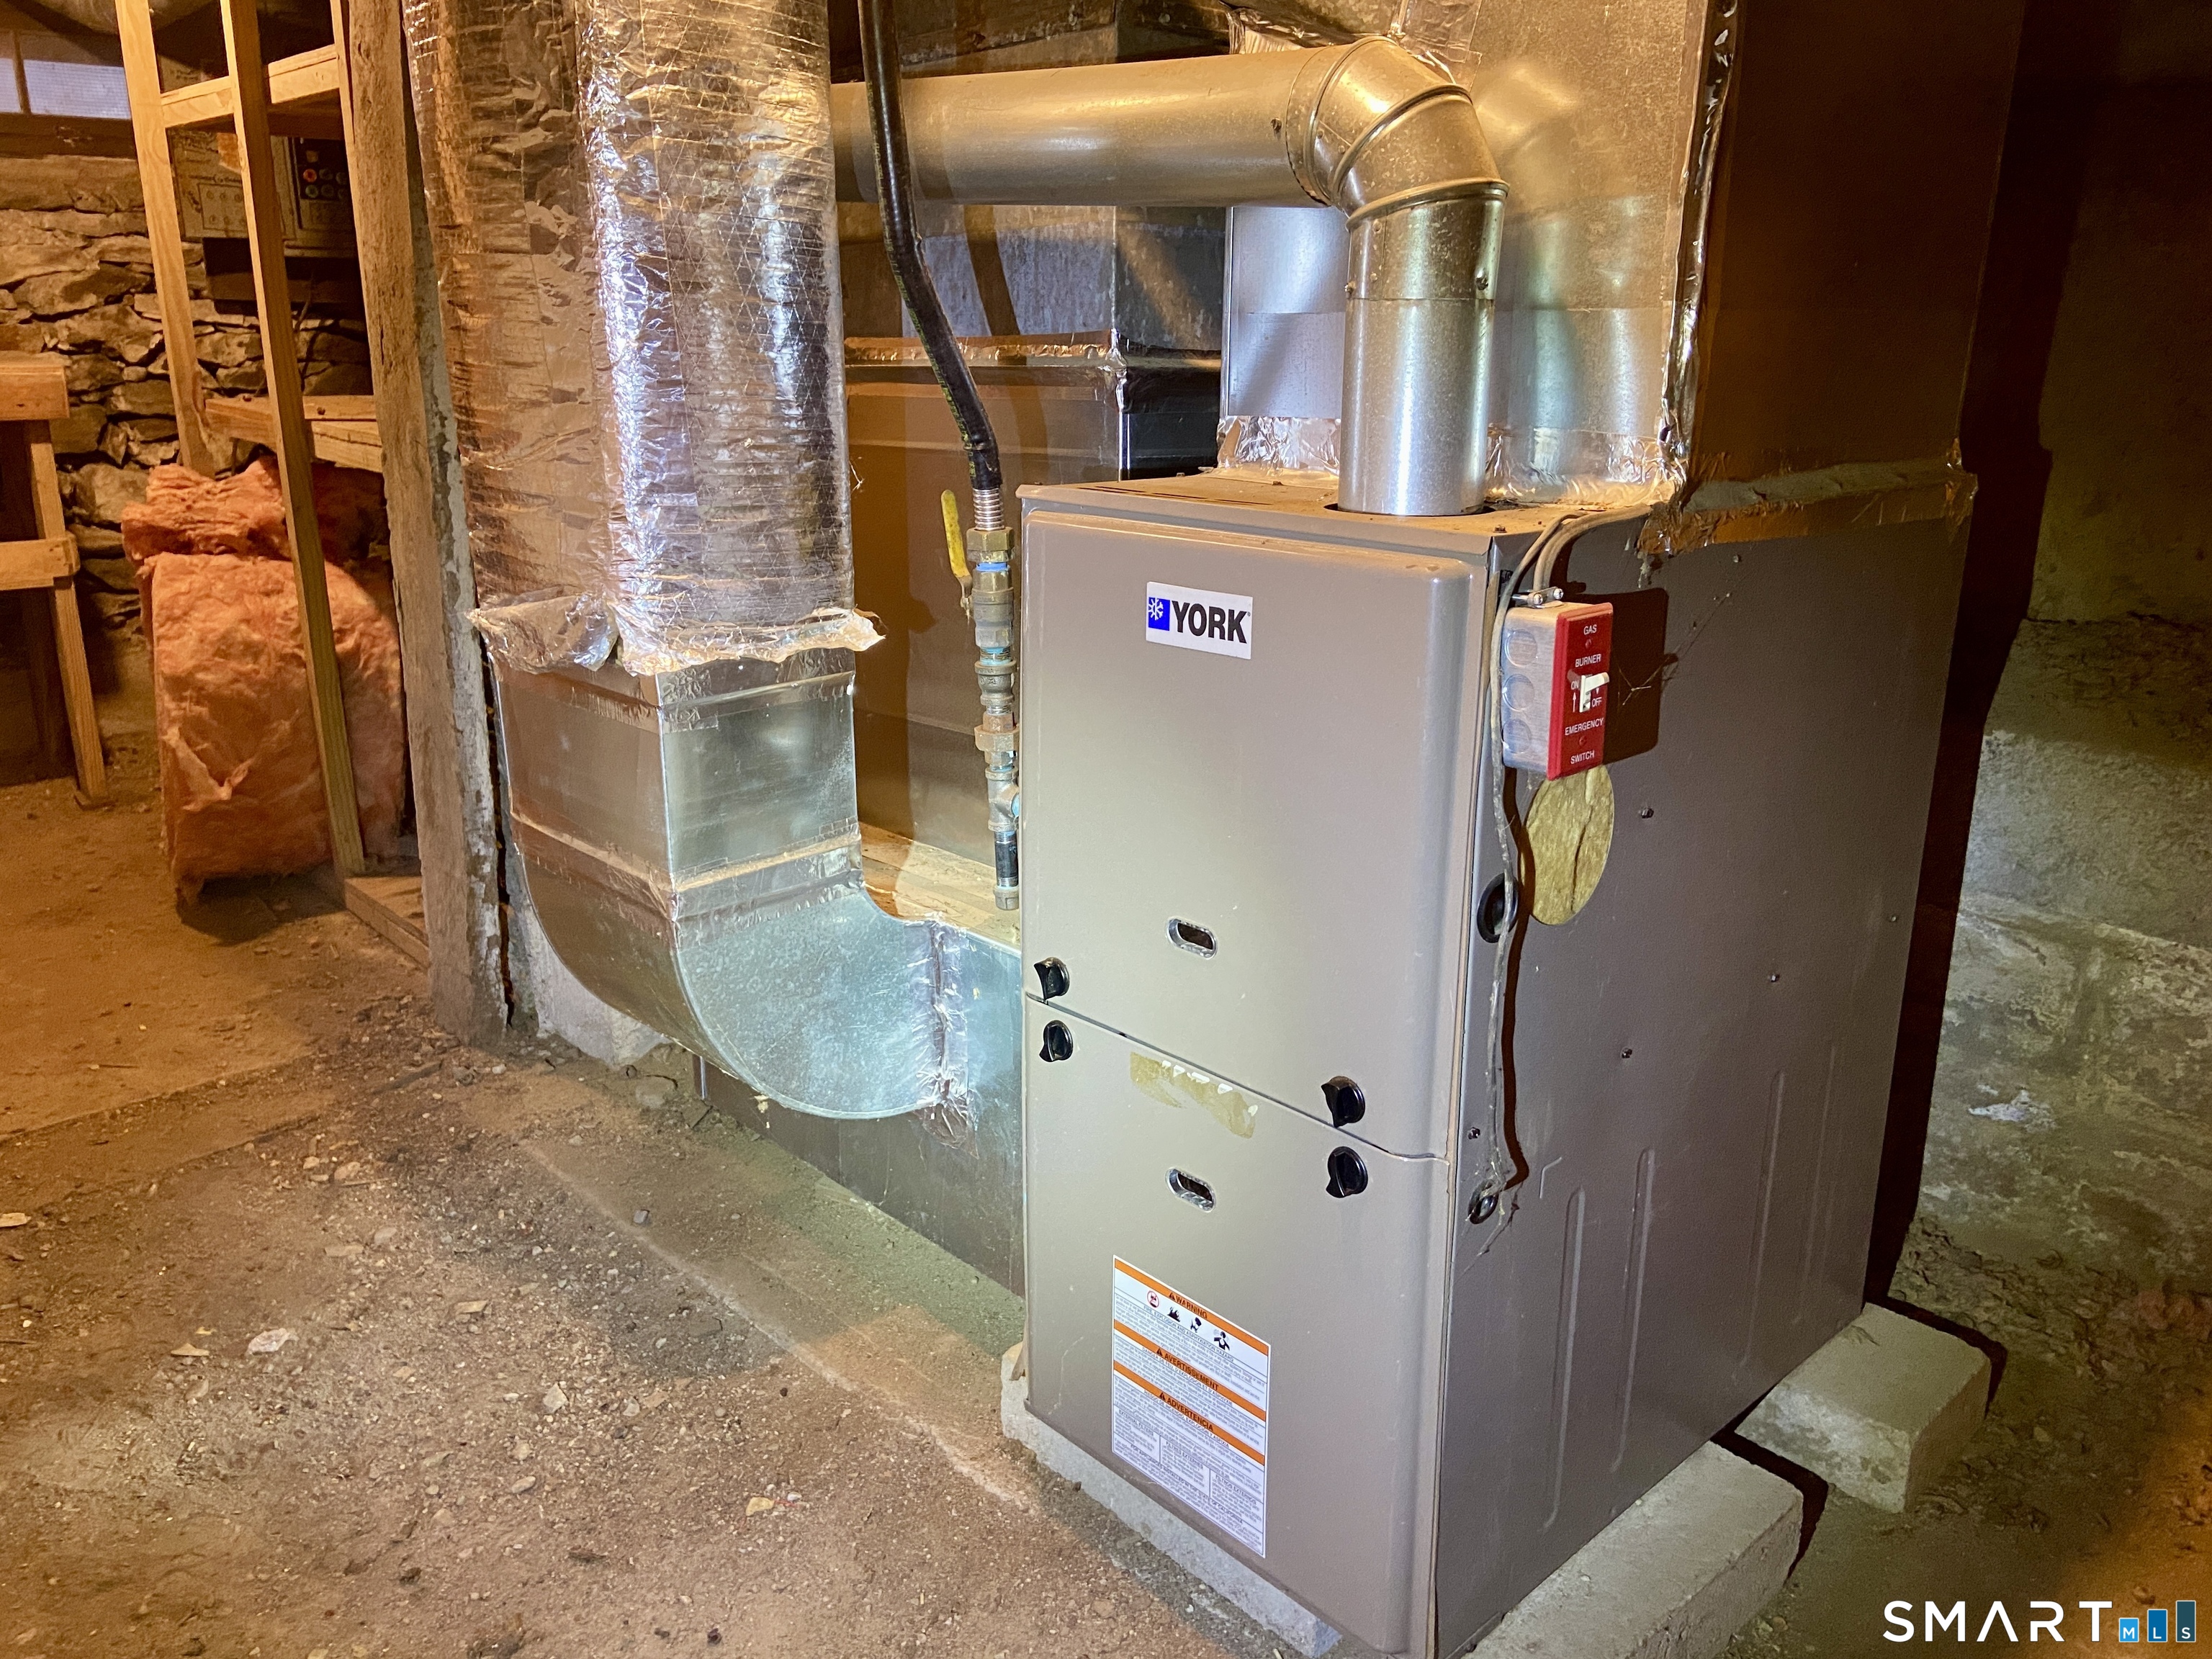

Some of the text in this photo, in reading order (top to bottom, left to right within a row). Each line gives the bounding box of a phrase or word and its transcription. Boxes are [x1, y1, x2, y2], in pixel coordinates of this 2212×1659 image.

[1172, 601, 1247, 644] YORK
[1583, 624, 1597, 636] GAS
[1575, 654, 1601, 667] BURNER
[1570, 680, 1580, 691] ON
[1592, 696, 1602, 708] OFF
[1565, 717, 1604, 736] EMERGENCY
[1570, 750, 1594, 765] SWITCH
[1176, 1295, 1207, 1319] WARNING
[1164, 1352, 1218, 1391] AVERTISSEMENT
[1166, 1395, 1213, 1431] ADVERTENCIA
